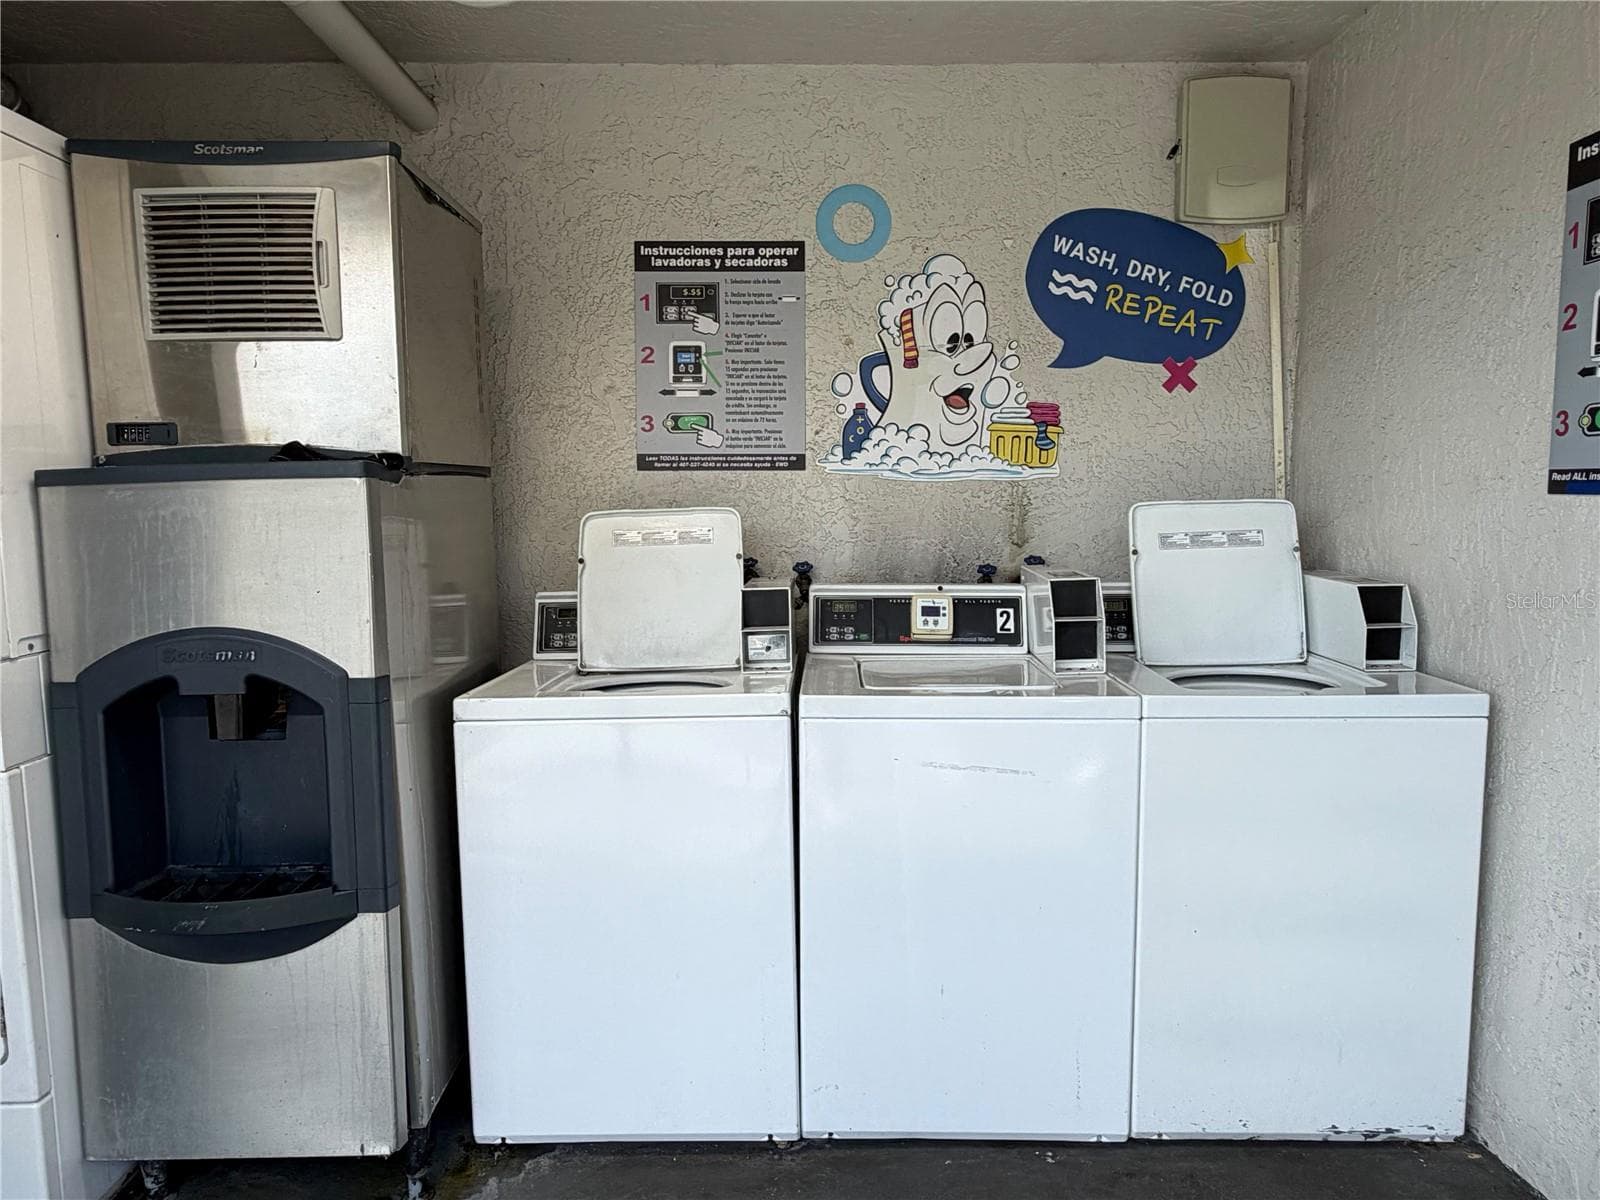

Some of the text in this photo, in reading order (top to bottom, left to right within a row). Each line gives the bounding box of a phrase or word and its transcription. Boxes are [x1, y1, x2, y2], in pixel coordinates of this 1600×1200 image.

[1568, 222, 1579, 250] 1
[640, 245, 799, 258] Instrucciones para operar
[651, 256, 788, 269] lavadoras y secadoras
[1053, 234, 1234, 308] WASH, DRY, FOLD
[640, 294, 650, 312] 1
[1105, 284, 1223, 340] REPEAT
[1562, 303, 1578, 331] 2
[640, 346, 655, 364] 2
[640, 414, 655, 432] 3
[1555, 410, 1570, 438] 3
[1552, 472, 1571, 480] Read
[1572, 472, 1587, 480] ALL
[999, 610, 1012, 632] 2
